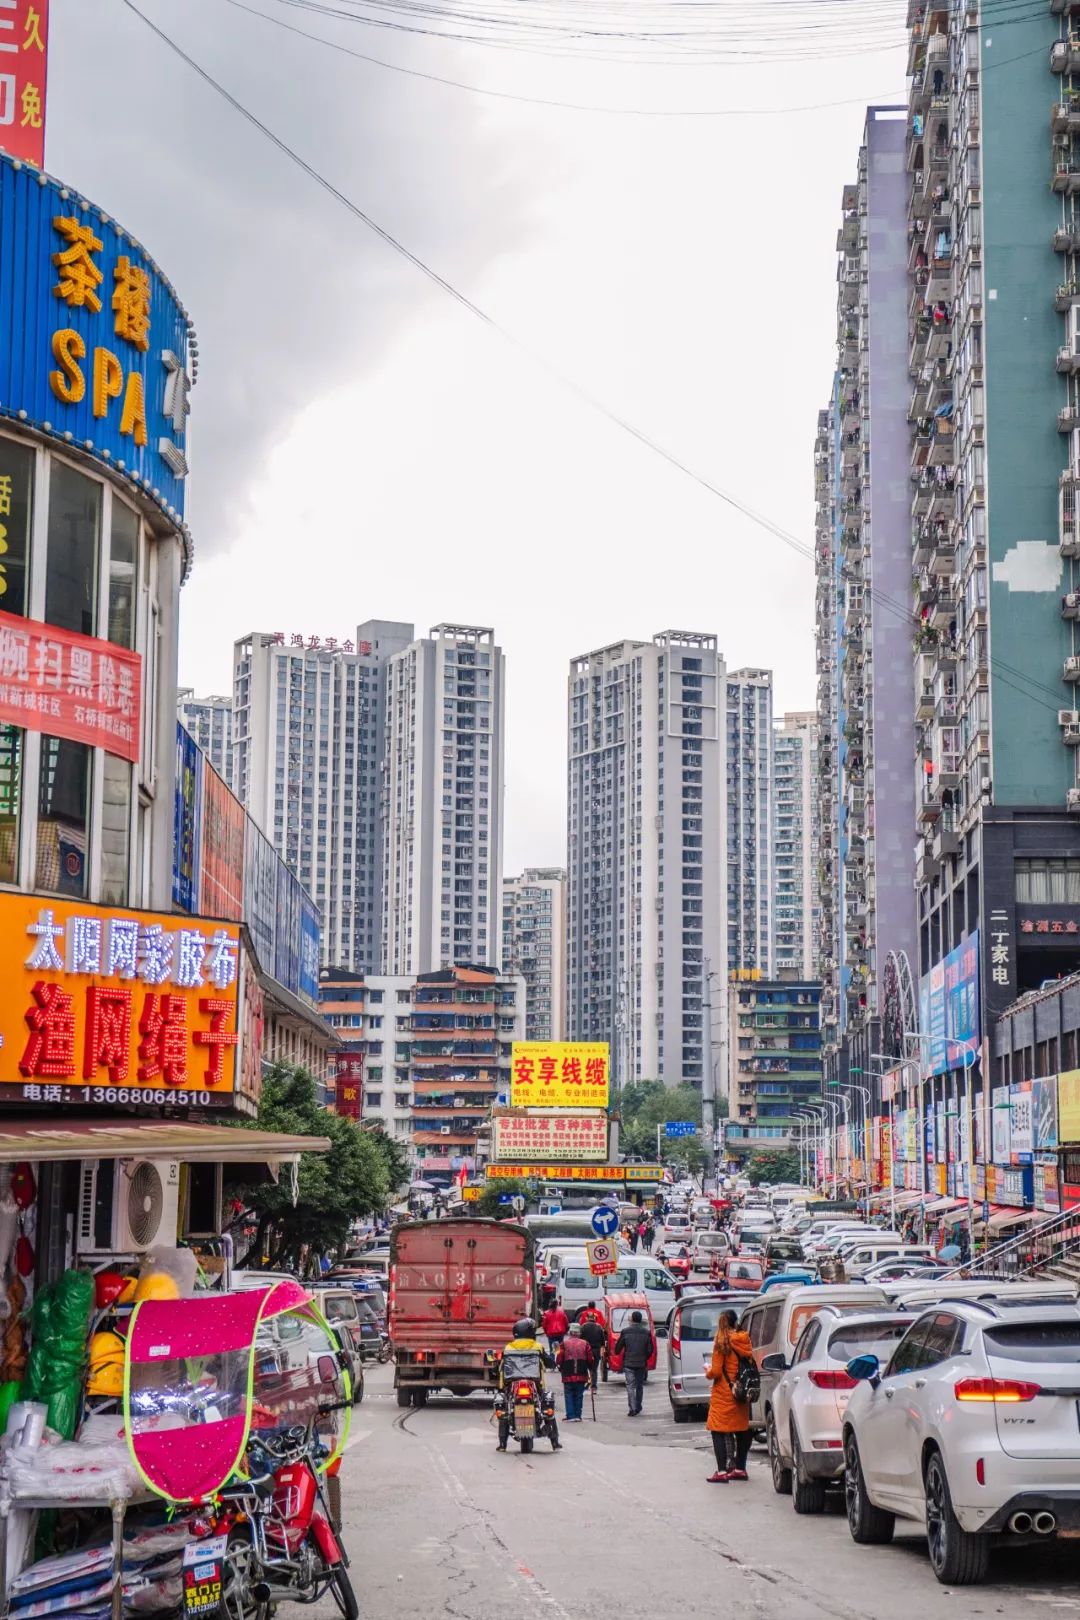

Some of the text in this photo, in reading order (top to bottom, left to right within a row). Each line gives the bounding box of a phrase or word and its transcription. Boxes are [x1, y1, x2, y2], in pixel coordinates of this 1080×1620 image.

[50, 329, 147, 447] SPA
[19, 981, 240, 1085] 渔网绳子
[514, 1056, 606, 1086] 安享线缆
